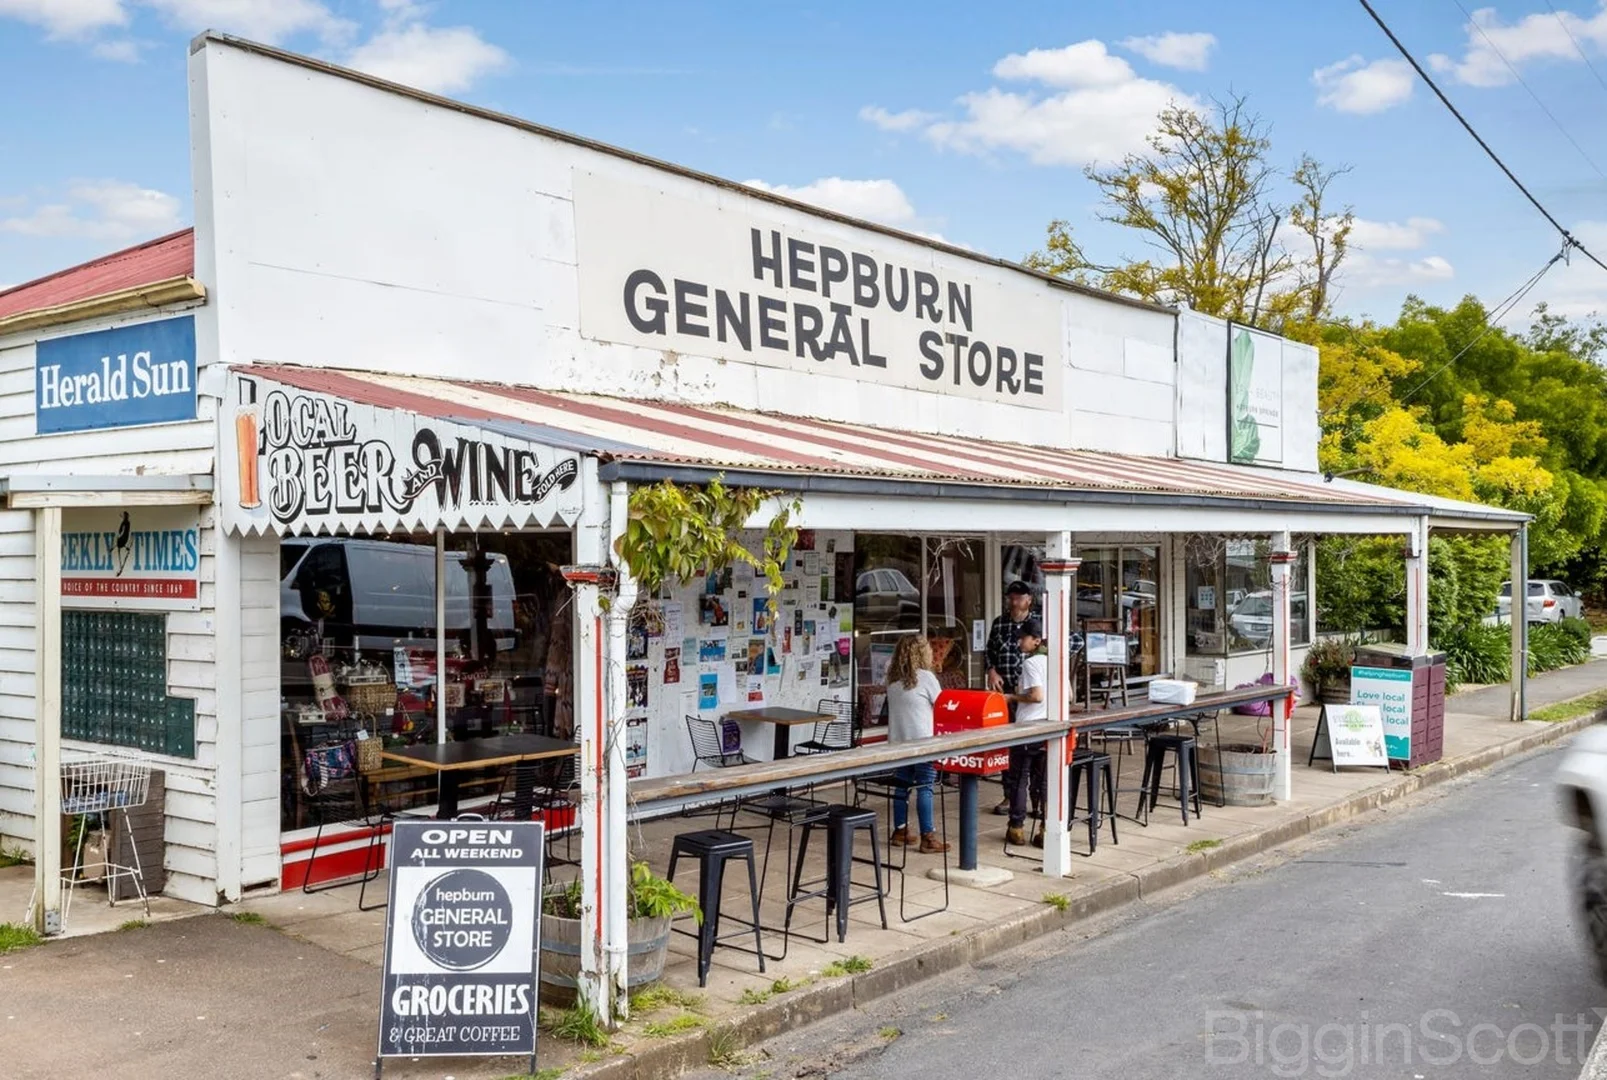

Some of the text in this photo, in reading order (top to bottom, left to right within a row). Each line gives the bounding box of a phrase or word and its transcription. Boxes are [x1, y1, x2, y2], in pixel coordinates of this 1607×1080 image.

[751, 228, 973, 331] HEPBURN
[623, 268, 1044, 395] GENERAL STORE
[40, 351, 191, 409] Herald Sun
[268, 428, 575, 524] BEER AND WINE SOLD HERE
[61, 529, 197, 571] EEKLY TIMES
[63, 583, 183, 594] VOICE OF THE COUNTRY SINCE 1869
[1357, 690, 1405, 702] Love local
[1382, 703, 1406, 713] local
[1386, 715, 1409, 725] local
[951, 755, 984, 768] POST
[421, 829, 513, 845] OPEN
[410, 848, 523, 859] ALL WEEKEND
[436, 887, 495, 903] hepburn
[420, 908, 508, 925] GENERAL
[433, 930, 493, 948] STORE
[391, 984, 531, 1016] GROCERIES
[389, 1025, 521, 1043] & GREAT COFFEE
